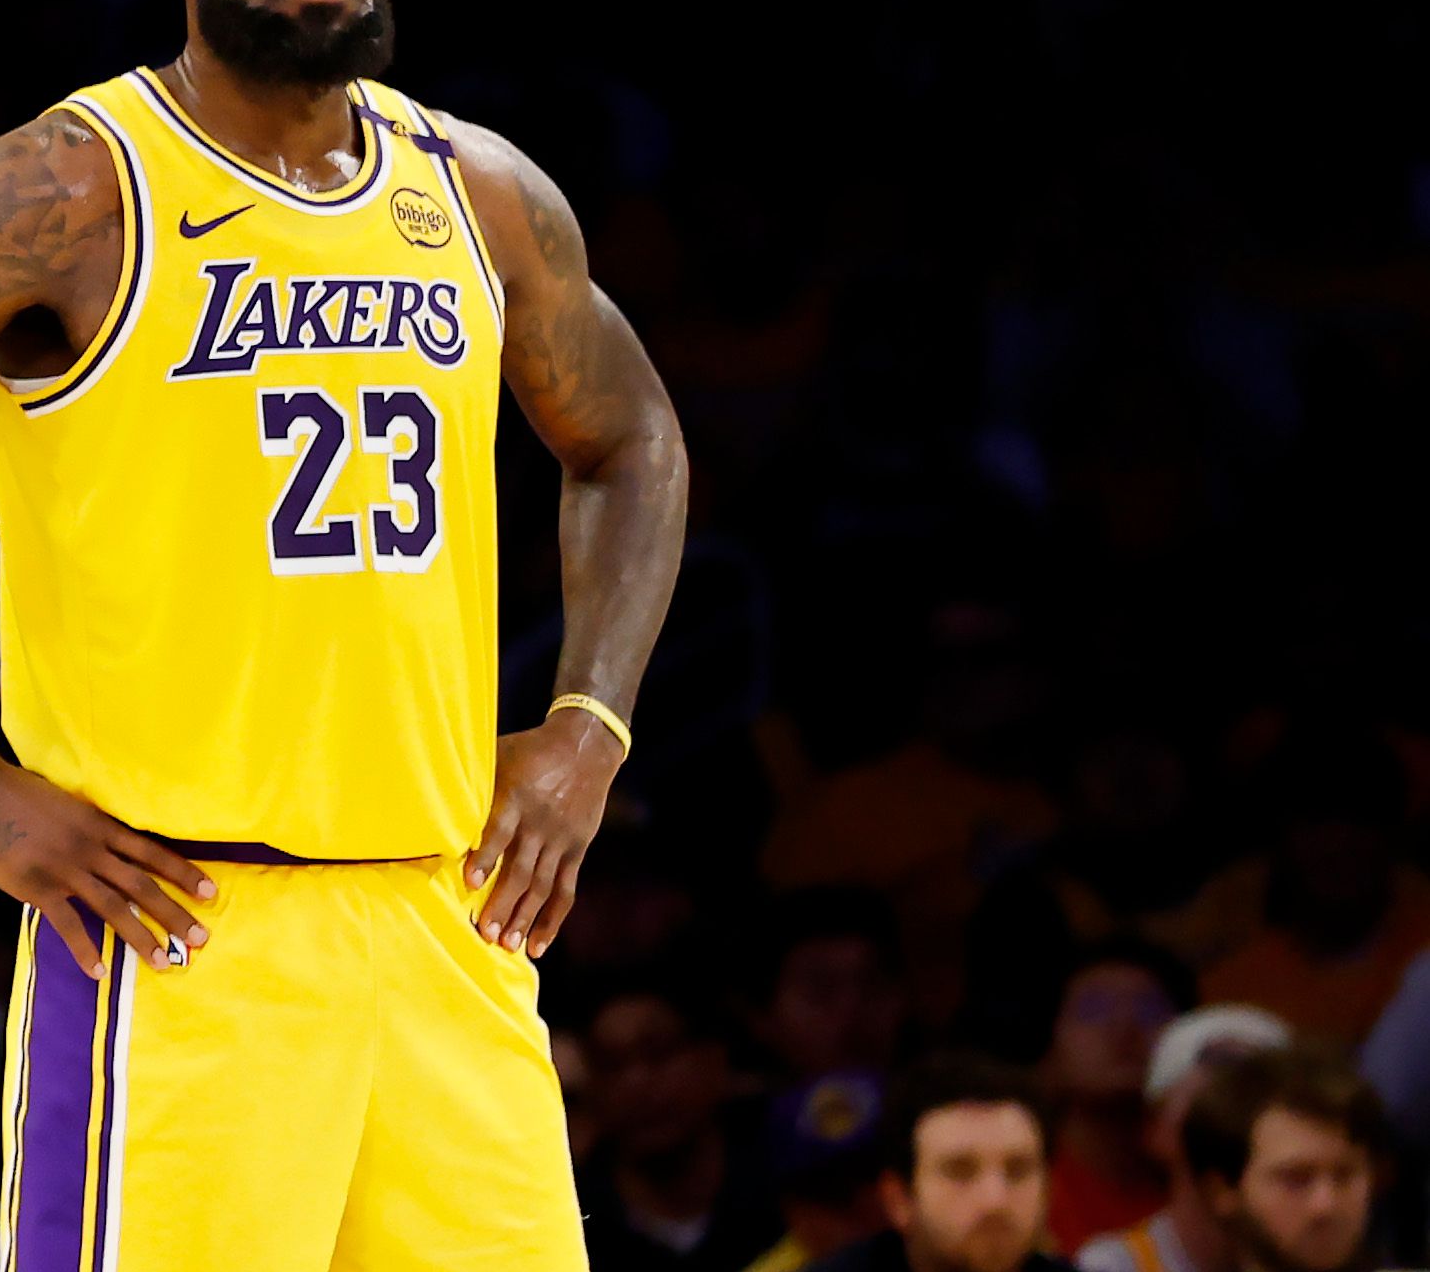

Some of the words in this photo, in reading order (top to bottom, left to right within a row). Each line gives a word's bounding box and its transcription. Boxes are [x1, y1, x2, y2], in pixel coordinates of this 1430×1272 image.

[395, 202, 447, 232] bibigo
[165, 257, 468, 382] LAKERS
[256, 384, 443, 577] 23
